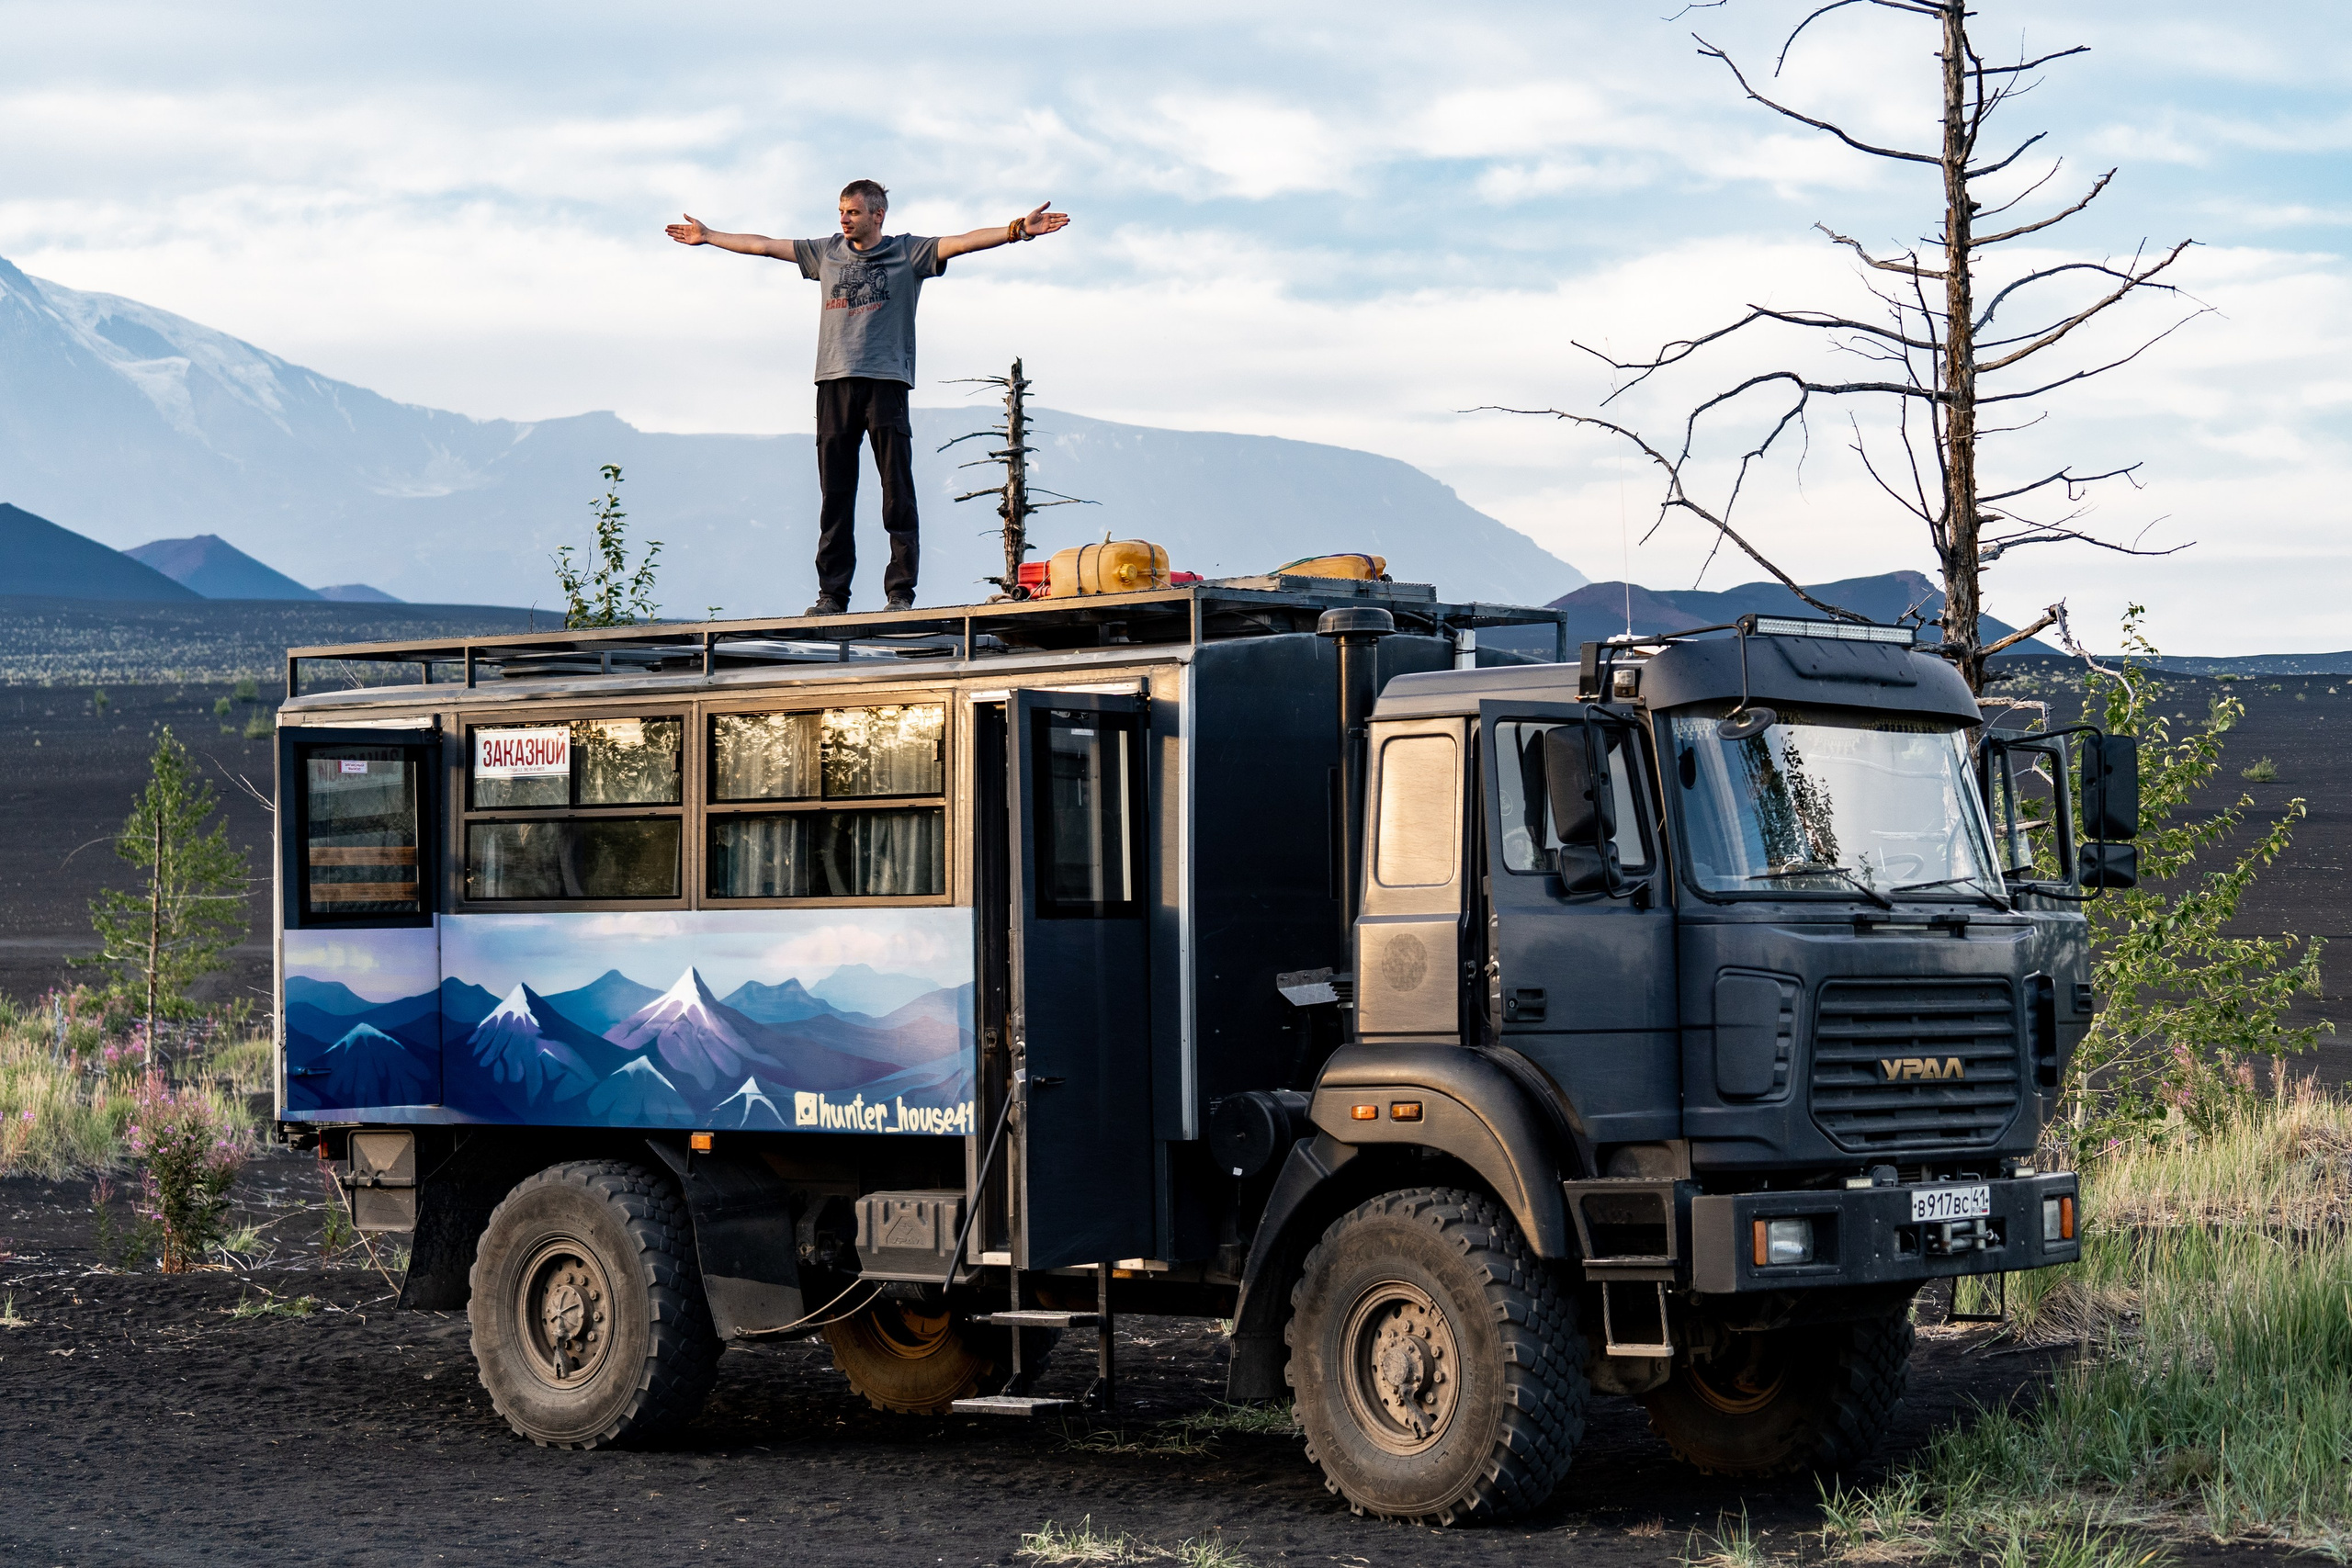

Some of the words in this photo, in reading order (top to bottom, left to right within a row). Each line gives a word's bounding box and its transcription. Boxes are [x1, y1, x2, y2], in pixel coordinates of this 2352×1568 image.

[825, 298, 848, 310] HARD
[848, 290, 891, 310] MACHINE
[848, 306, 865, 317] EASY
[866, 302, 882, 311] WAY
[482, 731, 566, 768] ЗАКАЗНОЙ
[1880, 1057, 1965, 1081] УРАЛ
[819, 1093, 975, 1135] hunter_house41
[1973, 1188, 1985, 1207] 41
